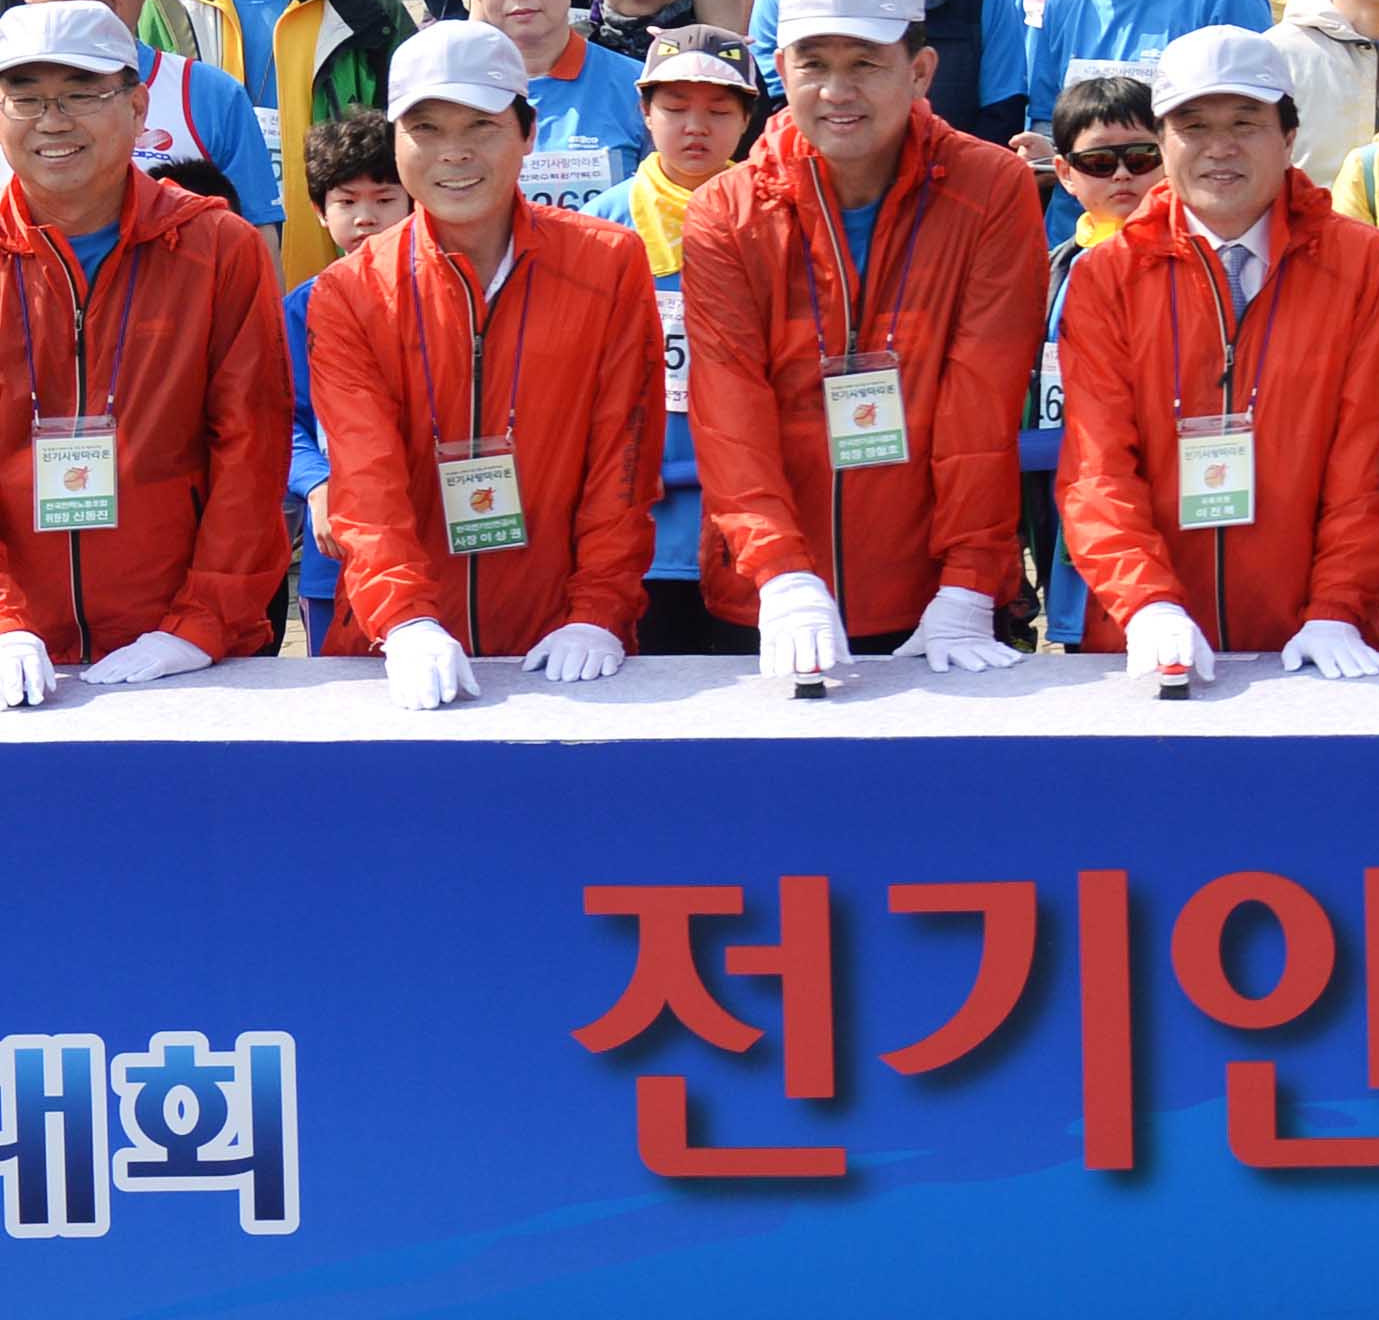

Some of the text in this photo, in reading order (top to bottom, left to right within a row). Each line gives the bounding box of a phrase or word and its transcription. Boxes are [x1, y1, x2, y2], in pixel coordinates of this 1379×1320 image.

[531, 156, 601, 170] 전기사랑마라톤
[831, 383, 895, 401] 전기사랑마라톤
[42, 449, 111, 464] 전기사랑마라톤
[1184, 446, 1247, 462] 전기사랑마라톤
[446, 468, 513, 488] 전기사랑마라톤
[453, 534, 478, 549] 사장
